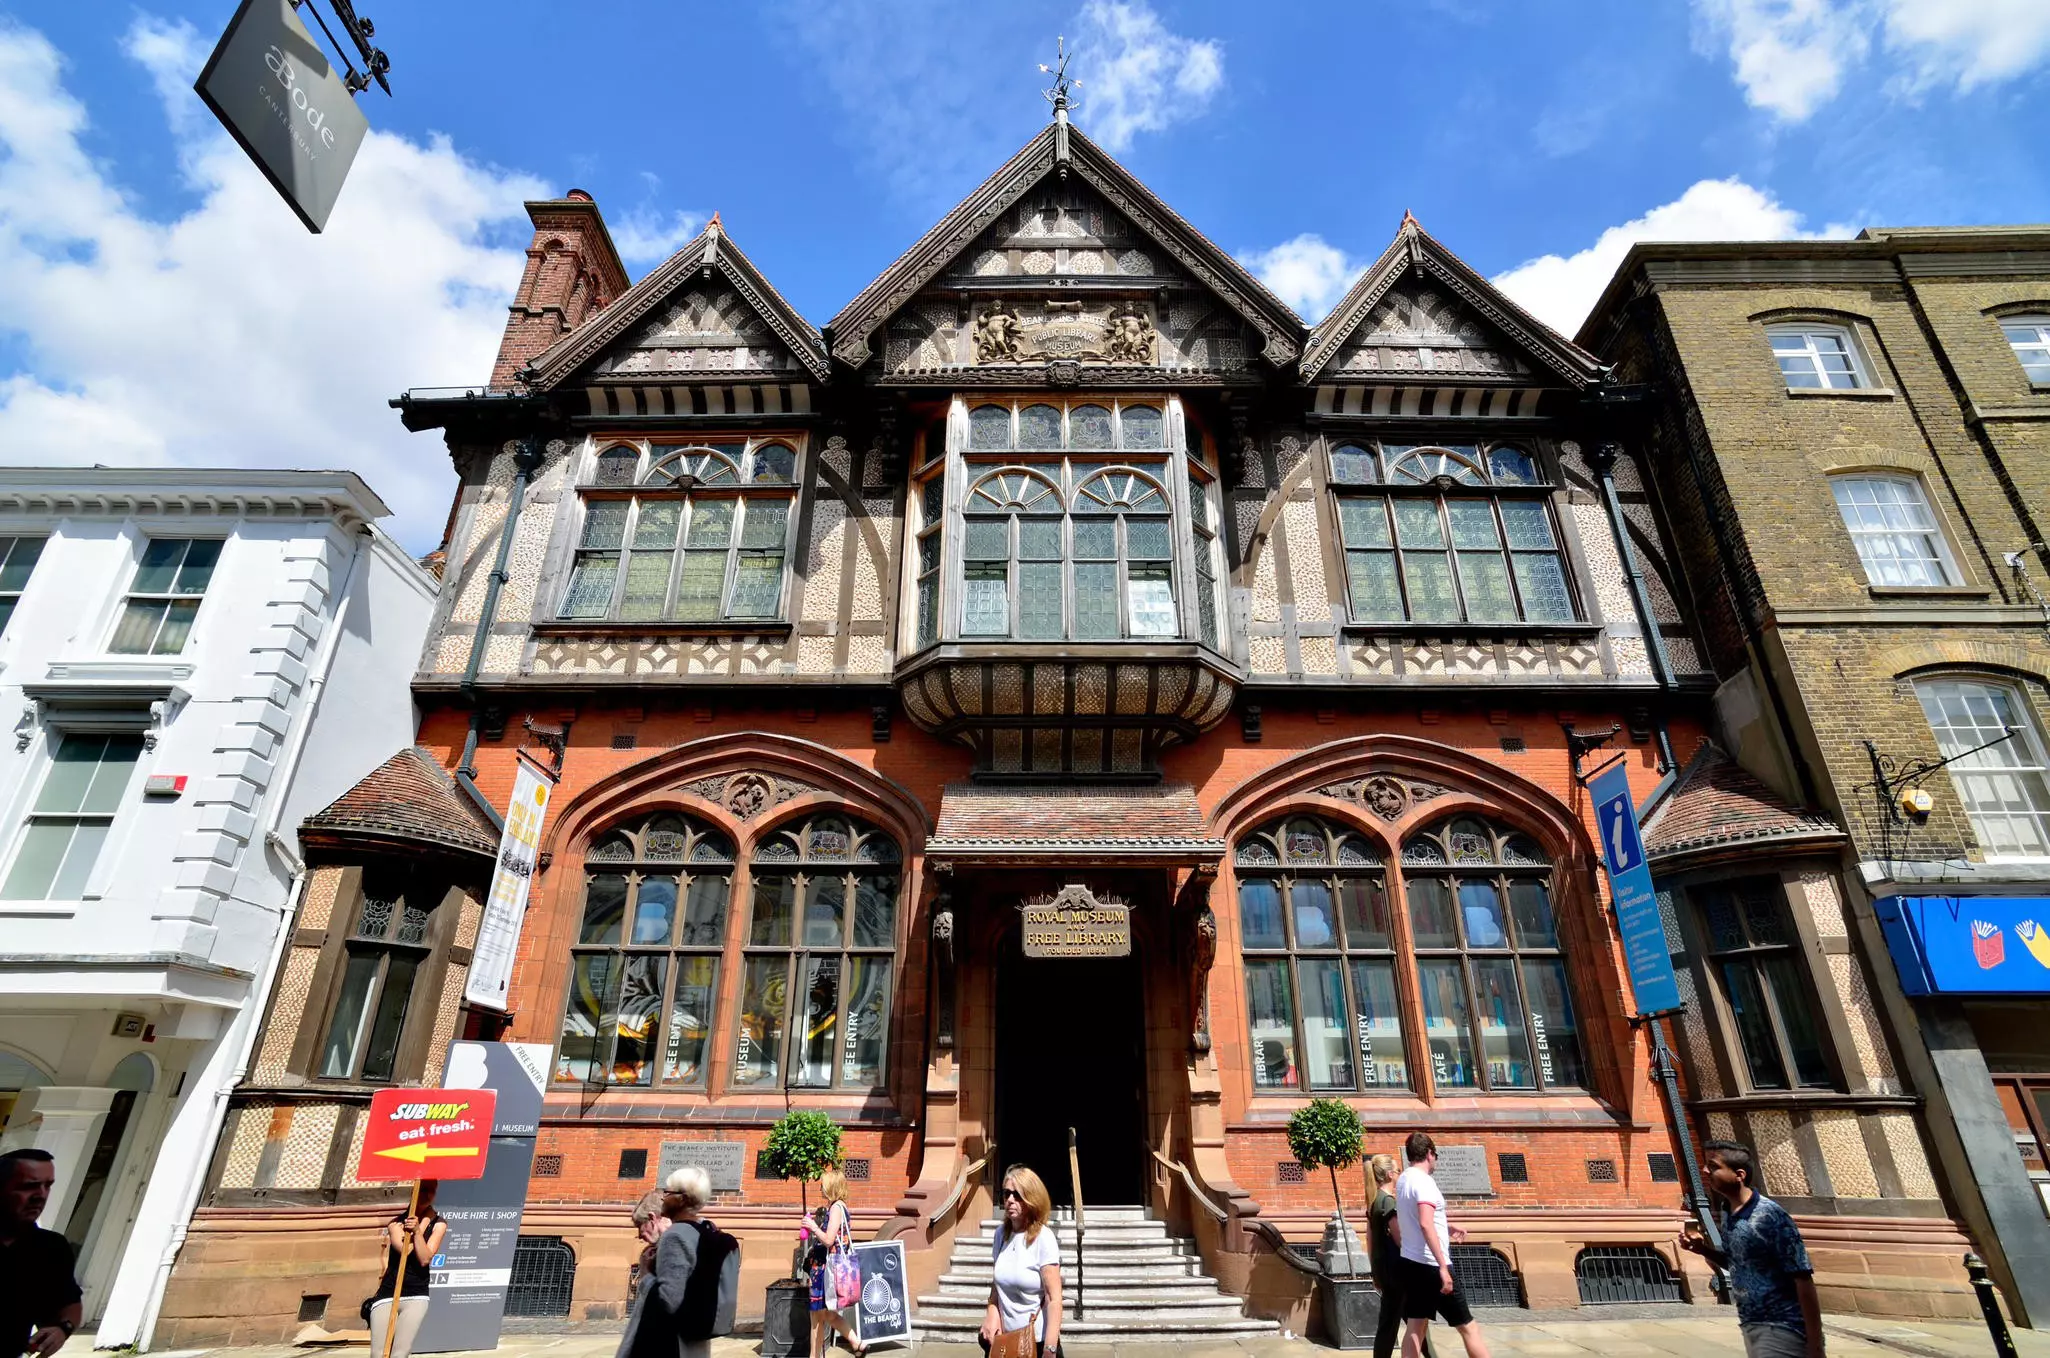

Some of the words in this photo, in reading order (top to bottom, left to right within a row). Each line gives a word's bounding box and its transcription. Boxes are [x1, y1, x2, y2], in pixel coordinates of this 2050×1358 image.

[259, 86, 317, 162] CANTERBURY
[1031, 328, 1060, 343] PUBLIC
[1063, 328, 1099, 343] LIBRARY
[1045, 341, 1082, 350] MUSEUM
[1027, 911, 1067, 924] ROYAL
[1071, 911, 1125, 924] MUSEUM
[1027, 933, 1061, 946] FREE
[668, 1009, 683, 1047] ENTRY
[847, 1010, 859, 1047] ENTRY
[1357, 1013, 1372, 1051] ENTRY
[1532, 1013, 1549, 1050] ENTRY
[515, 1046, 530, 1064] FREE
[527, 1062, 545, 1085] ENTRY
[736, 1027, 751, 1080] MUSEUM
[1363, 1053, 1376, 1083] FREE
[1432, 1053, 1447, 1083] CAFÉ
[1539, 1053, 1555, 1082] FREE
[390, 1102, 470, 1121] SUBWAY
[399, 1126, 425, 1140] eat
[502, 1124, 534, 1132] MUSEUM
[442, 1211, 469, 1220] VENUE
[469, 1211, 488, 1220] HIRE
[496, 1211, 518, 1220] SHOP
[864, 1316, 877, 1325] THE
[877, 1313, 901, 1322] BEANEY
